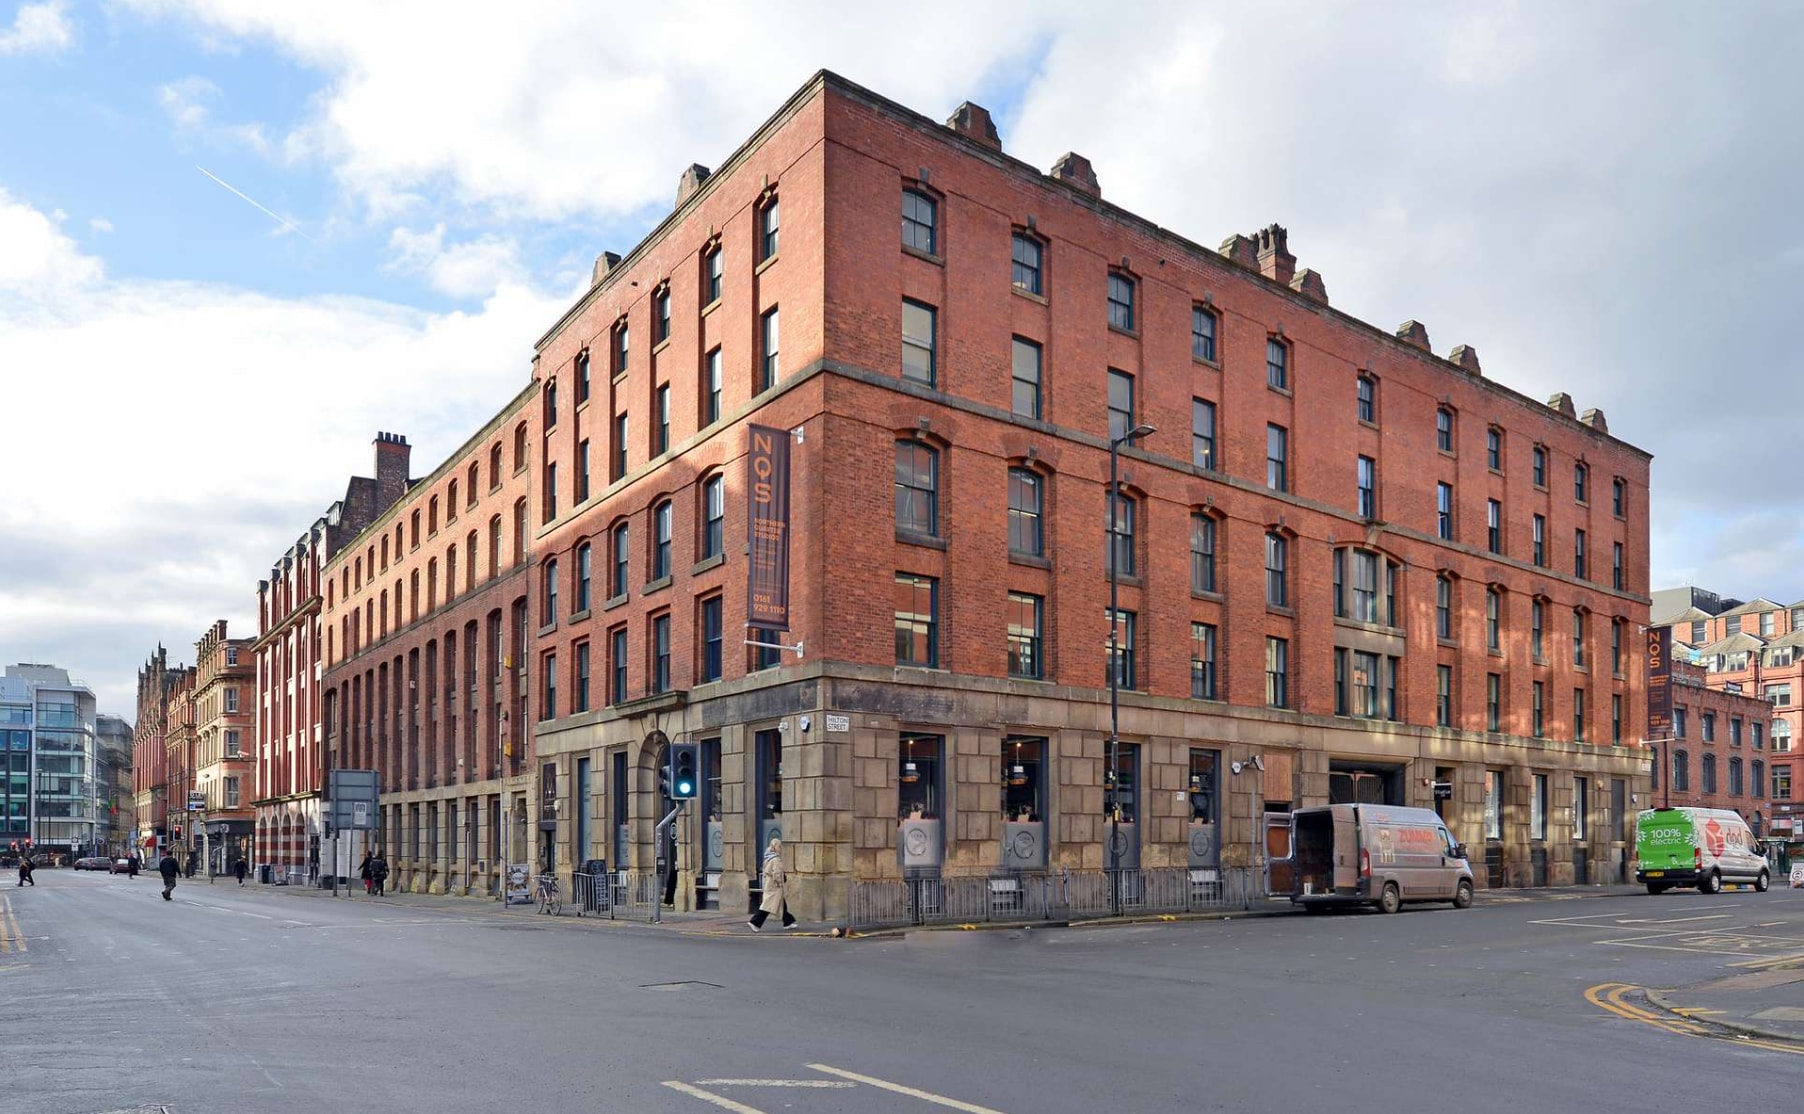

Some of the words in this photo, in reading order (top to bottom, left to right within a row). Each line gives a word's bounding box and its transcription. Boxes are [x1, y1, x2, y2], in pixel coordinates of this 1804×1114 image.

[754, 433, 772, 503] NQS
[754, 594, 770, 603] 0161
[754, 603, 768, 612] 929
[770, 605, 785, 614] 1110
[1649, 632, 1660, 668] NQS
[828, 716, 848, 724] HILTON
[1650, 828, 1681, 838] 100%
[1726, 827, 1743, 848] dpd
[1650, 838, 1681, 846] electric
